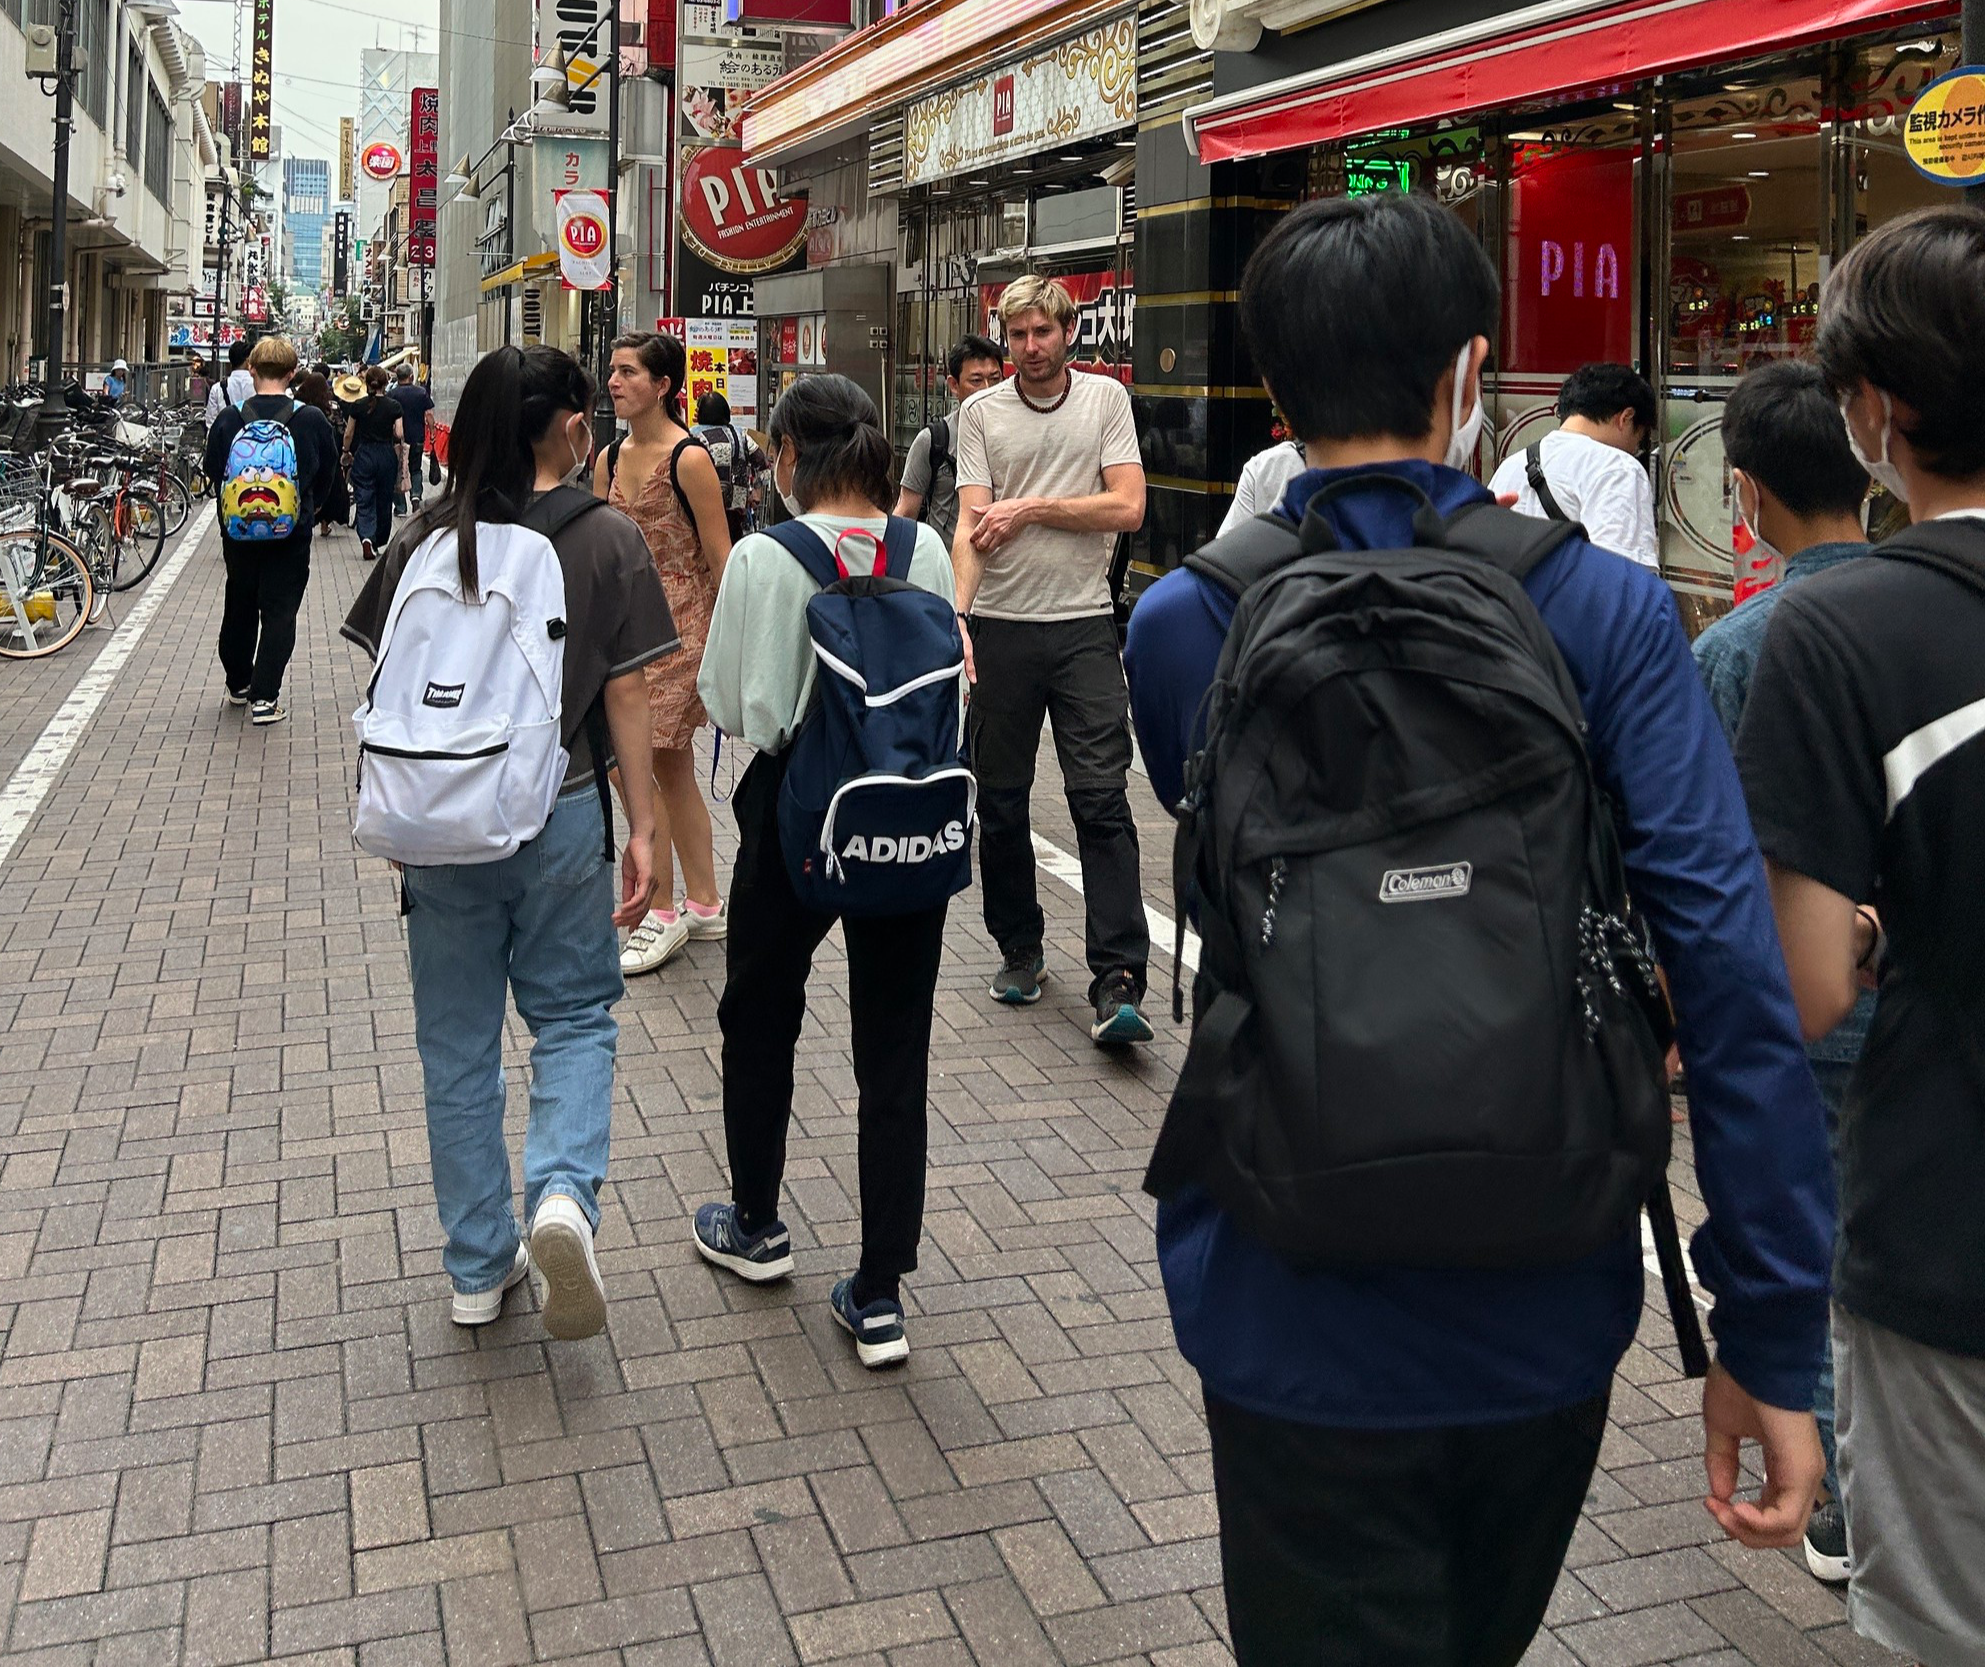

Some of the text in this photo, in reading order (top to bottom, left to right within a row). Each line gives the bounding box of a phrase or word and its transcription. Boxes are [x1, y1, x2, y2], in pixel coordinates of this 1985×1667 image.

[997, 89, 1011, 117] PIA
[700, 166, 790, 227] PIA
[570, 225, 597, 243] PIA
[718, 221, 745, 239] FASHION
[746, 206, 794, 231] ENTERTAINMENT
[1541, 240, 1618, 298] PIA
[714, 362, 726, 389] 本日
[841, 820, 966, 864] ADIDAS
[1388, 871, 1452, 892] Coleman
